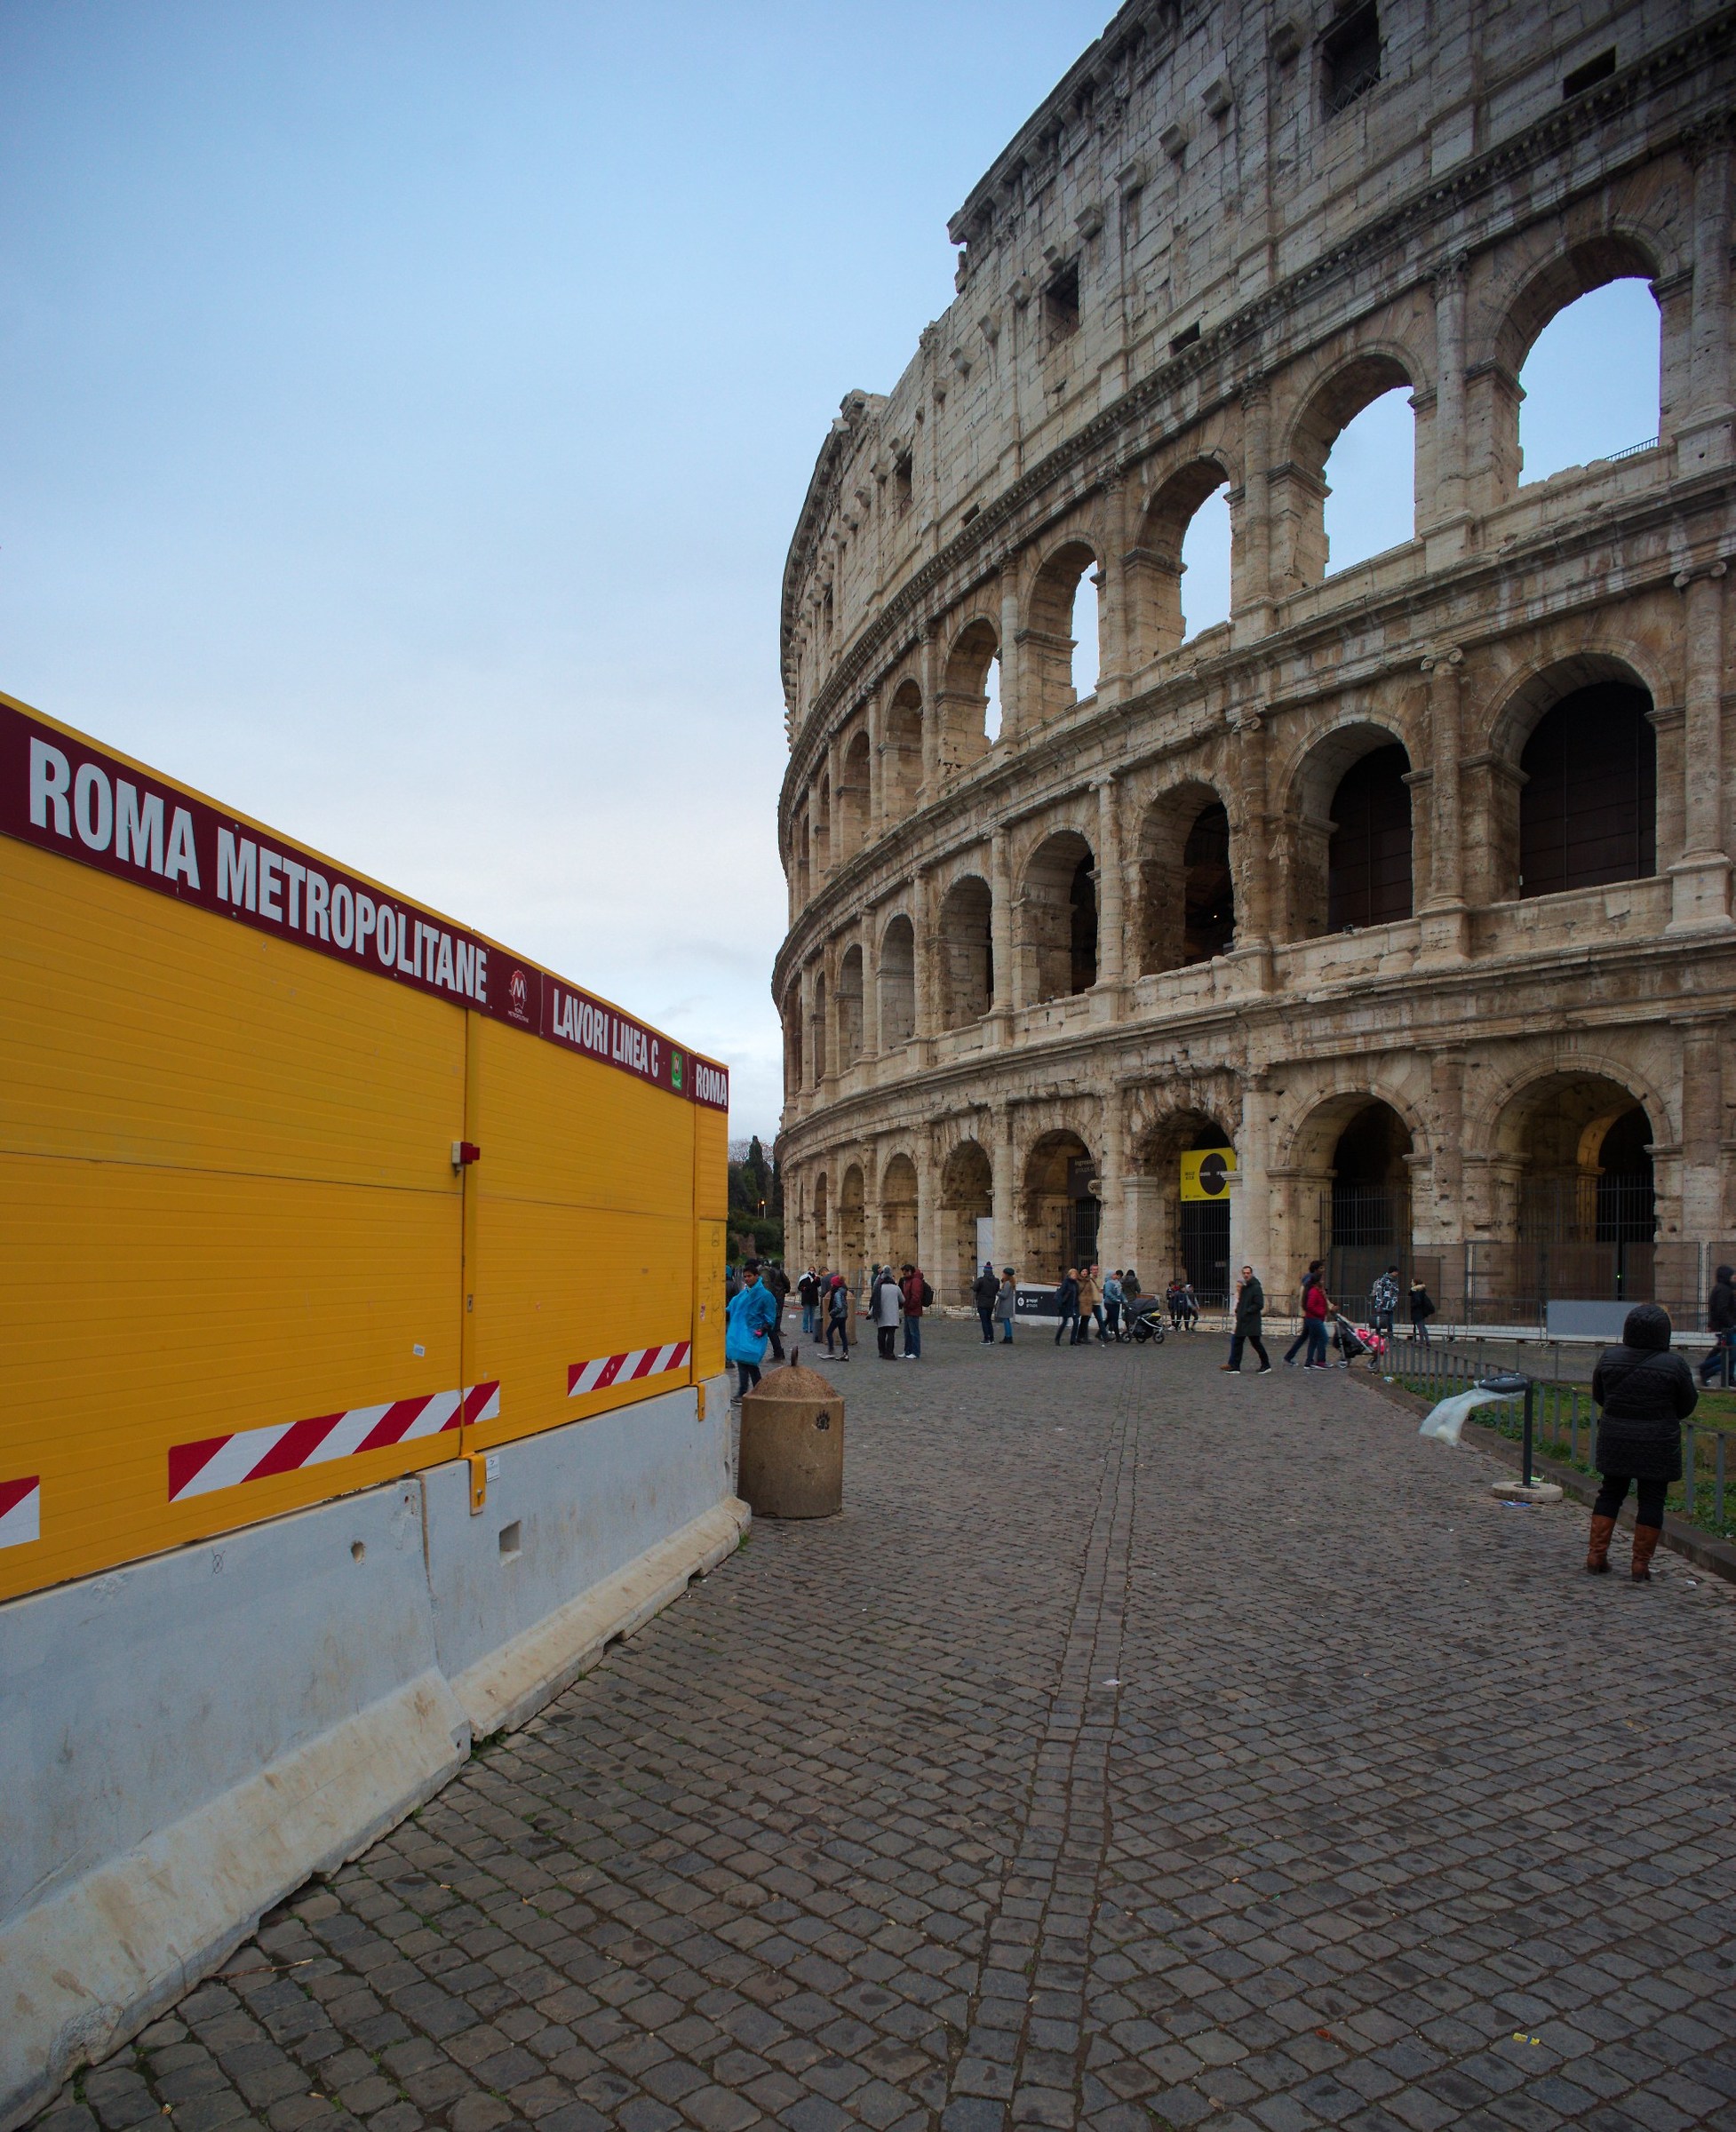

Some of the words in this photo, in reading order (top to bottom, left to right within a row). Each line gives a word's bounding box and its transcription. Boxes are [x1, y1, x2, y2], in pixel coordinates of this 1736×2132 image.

[29, 736, 201, 890] ROMA
[217, 826, 487, 1004] METROPOLITANE
[553, 988, 609, 1055] LAVORI
[612, 1018, 649, 1074] LINEA
[651, 1039, 659, 1078] C
[696, 1063, 728, 1106] ROMA
